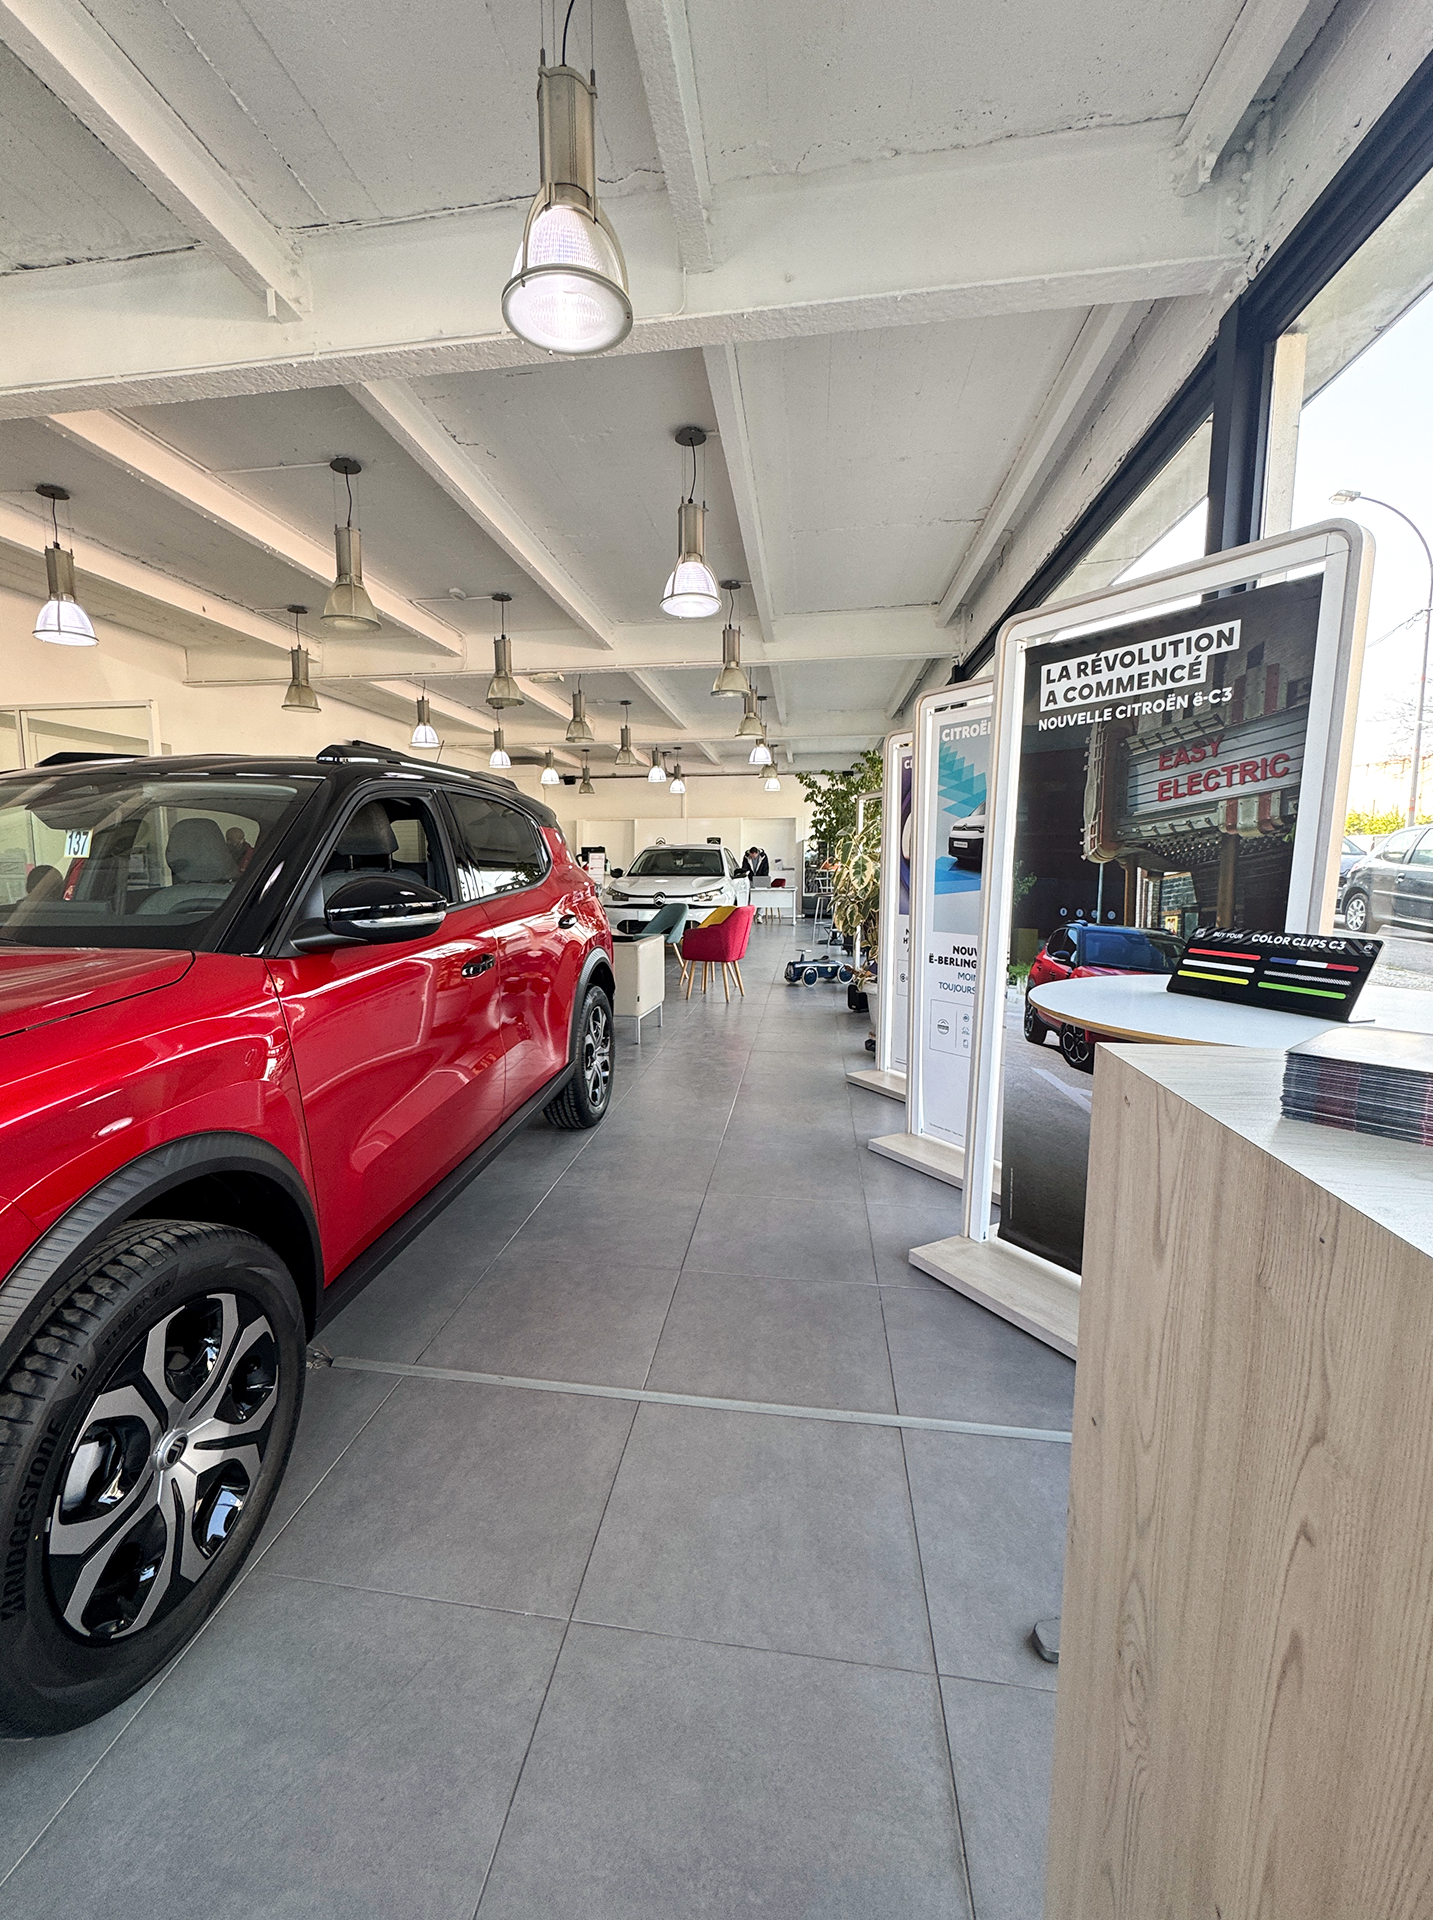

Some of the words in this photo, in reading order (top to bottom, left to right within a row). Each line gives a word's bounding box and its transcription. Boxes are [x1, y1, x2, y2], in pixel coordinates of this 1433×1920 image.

[1046, 665, 1070, 685] LA
[1077, 626, 1235, 678] RÉVOLUTION
[1045, 691, 1057, 707] A
[1063, 656, 1203, 703] COMMENCÉ
[1038, 708, 1112, 731] NOUVELLE
[1115, 693, 1189, 720] CITROËN
[1193, 687, 1233, 707] ë-C3
[1158, 734, 1225, 771] EASY
[1157, 753, 1291, 802] ELECTRIC
[68, 830, 89, 856] 137
[1252, 934, 1291, 945] COLOR
[1292, 937, 1327, 949] CLIPS
[1329, 940, 1347, 950] C3
